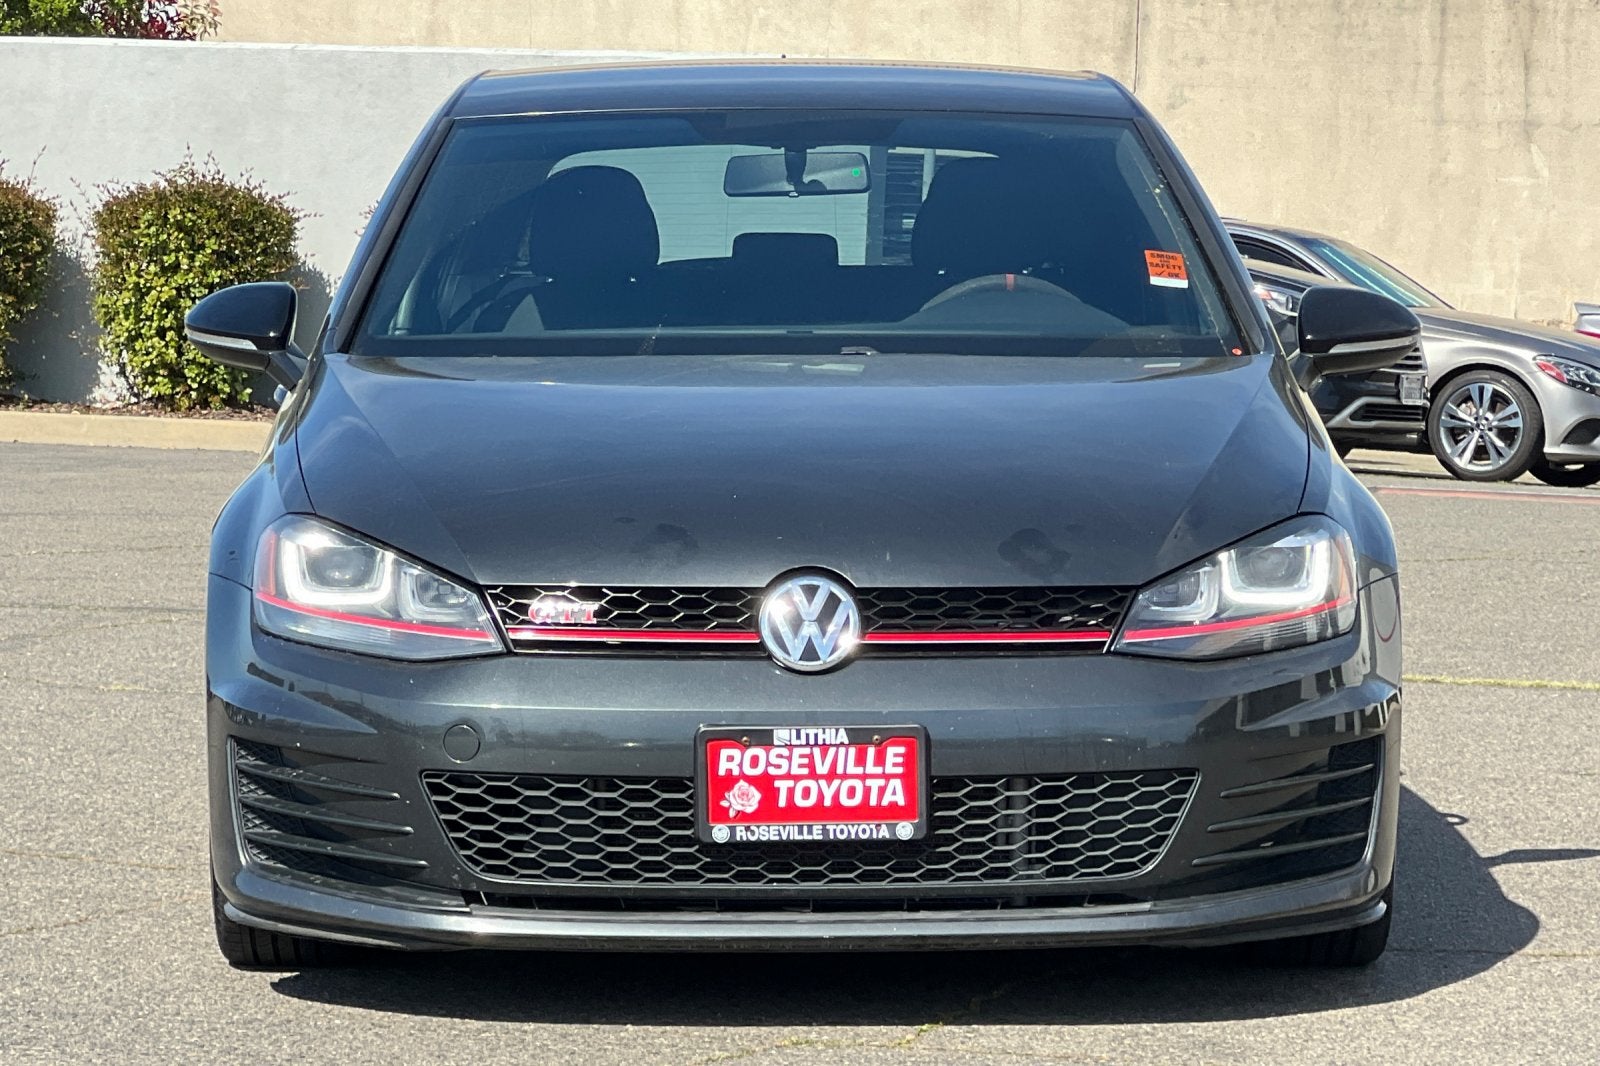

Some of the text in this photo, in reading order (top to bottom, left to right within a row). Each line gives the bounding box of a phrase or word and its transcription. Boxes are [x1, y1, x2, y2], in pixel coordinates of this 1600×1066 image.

[528, 598, 600, 625] GTI
[790, 728, 850, 746] LITHIA
[718, 747, 906, 776] ROSEVILLE
[773, 779, 906, 807] TOYOTA
[736, 824, 890, 841] ROSEVILLE TOYOTA
